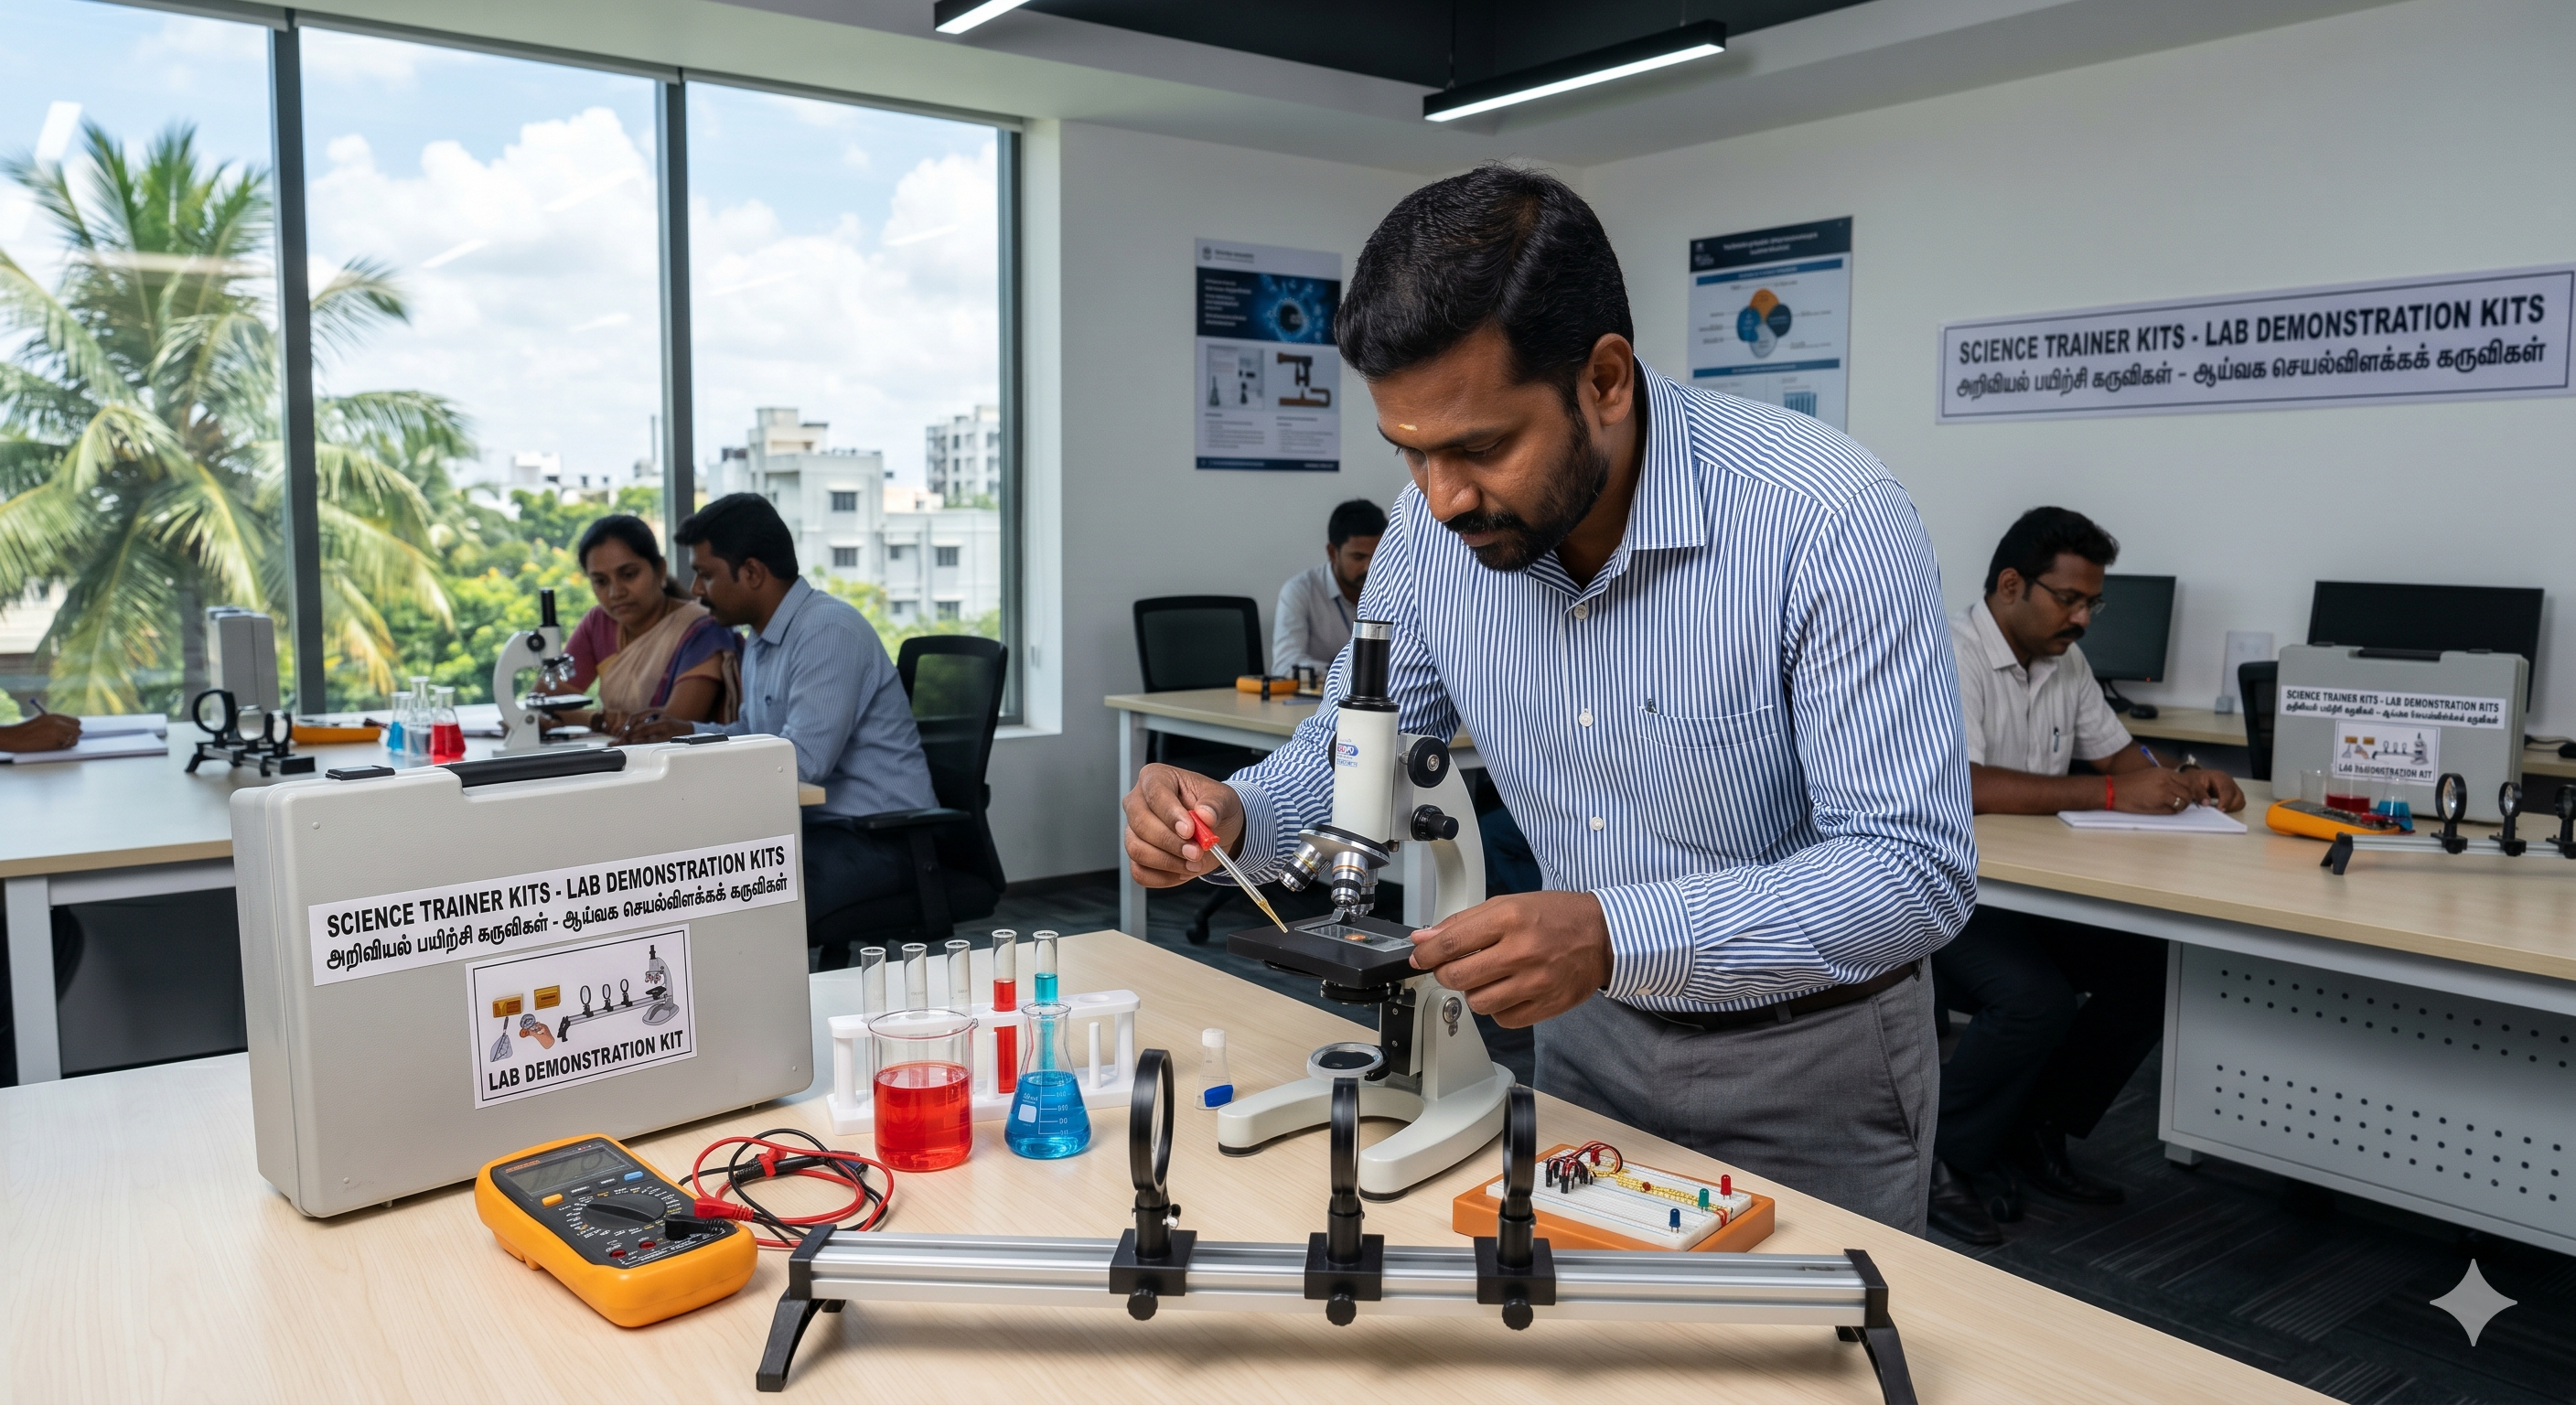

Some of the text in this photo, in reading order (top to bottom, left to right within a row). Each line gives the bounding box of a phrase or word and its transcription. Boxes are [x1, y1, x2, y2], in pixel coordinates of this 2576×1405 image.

[1959, 336, 2038, 365] SCIENCE
[2045, 328, 2131, 359] TRAINER
[2137, 323, 2185, 353] KITS
[2206, 318, 2249, 347] LAB
[2256, 300, 2472, 343] DEMONSTRATION
[2480, 294, 2546, 327] KITS
[1956, 370, 2030, 402] அறிவியல்
[2034, 366, 2088, 397] பயிற்சி
[2092, 360, 2174, 392] கருவிகள்
[2193, 356, 2267, 388] ஆய்வக
[2272, 342, 2431, 378] செயல்விளக்கக்
[2436, 335, 2546, 373] கருவிகள்
[2286, 690, 2321, 702] SCIENCE
[2404, 697, 2476, 712] DEMONSTRATION
[327, 902, 414, 938] SCIENCE
[419, 889, 504, 923] TRAINER
[509, 882, 551, 908] KITS
[566, 874, 601, 899] LAB
[606, 852, 745, 893] DEMONSTRATION
[750, 845, 785, 870] KITS
[327, 934, 412, 971] அறிவியல்
[417, 925, 473, 954] பயிற்சி
[478, 911, 549, 945] கருவிகள்
[563, 906, 619, 932] ஆய்வக
[623, 882, 726, 917] செயல்விளக்கக்
[730, 872, 788, 902] கருவிகள்
[488, 1030, 683, 1090] LAB DEMONSTRATION KIT
